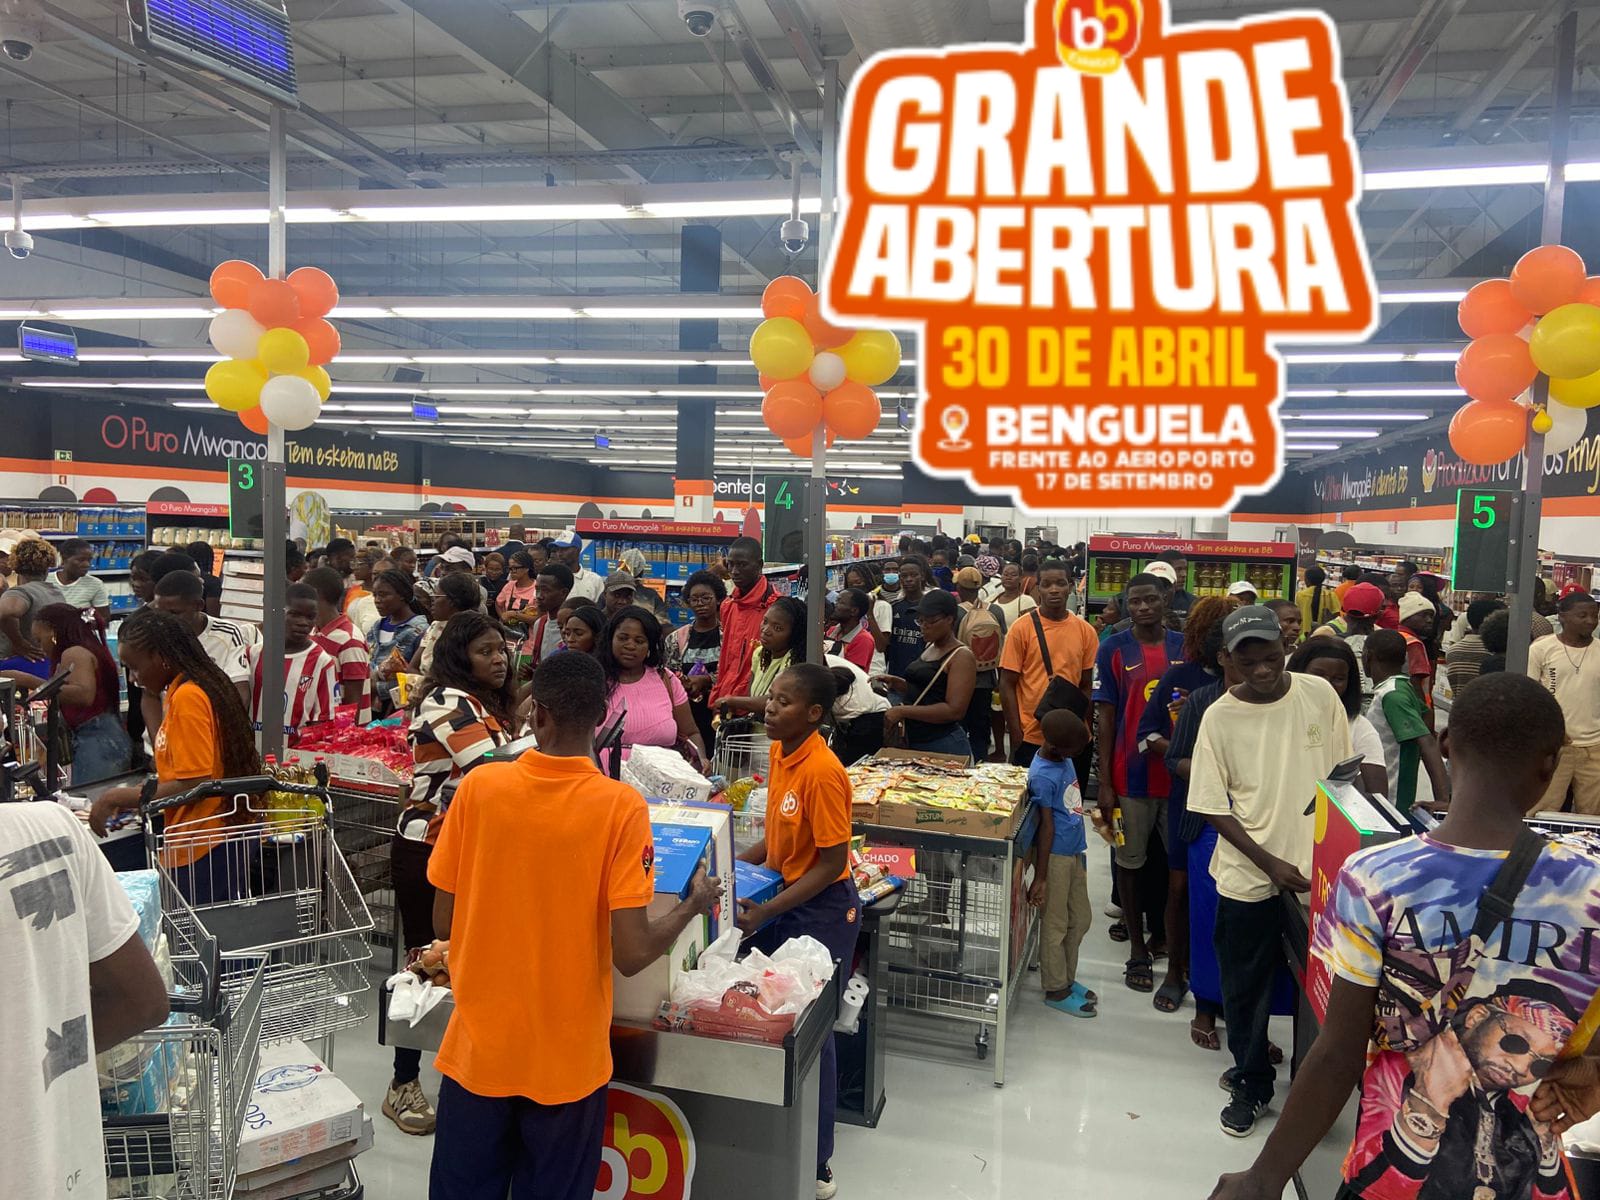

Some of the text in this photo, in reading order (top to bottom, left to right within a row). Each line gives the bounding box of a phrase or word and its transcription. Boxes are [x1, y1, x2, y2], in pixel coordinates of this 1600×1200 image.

[101, 414, 129, 449] O
[132, 416, 179, 453] Puro
[182, 424, 268, 460] Mwango
[285, 440, 314, 464] Tem
[238, 463, 254, 490] 3
[169, 504, 182, 512] Puro
[774, 481, 794, 510] 4
[1472, 495, 1496, 529] 5
[592, 520, 601, 530] O
[602, 521, 618, 530] Puro
[661, 524, 674, 532] Tem
[1110, 540, 1120, 549] O
[1122, 540, 1142, 550] Puro
[1195, 544, 1213, 553] Tem
[1261, 546, 1273, 554] BB
